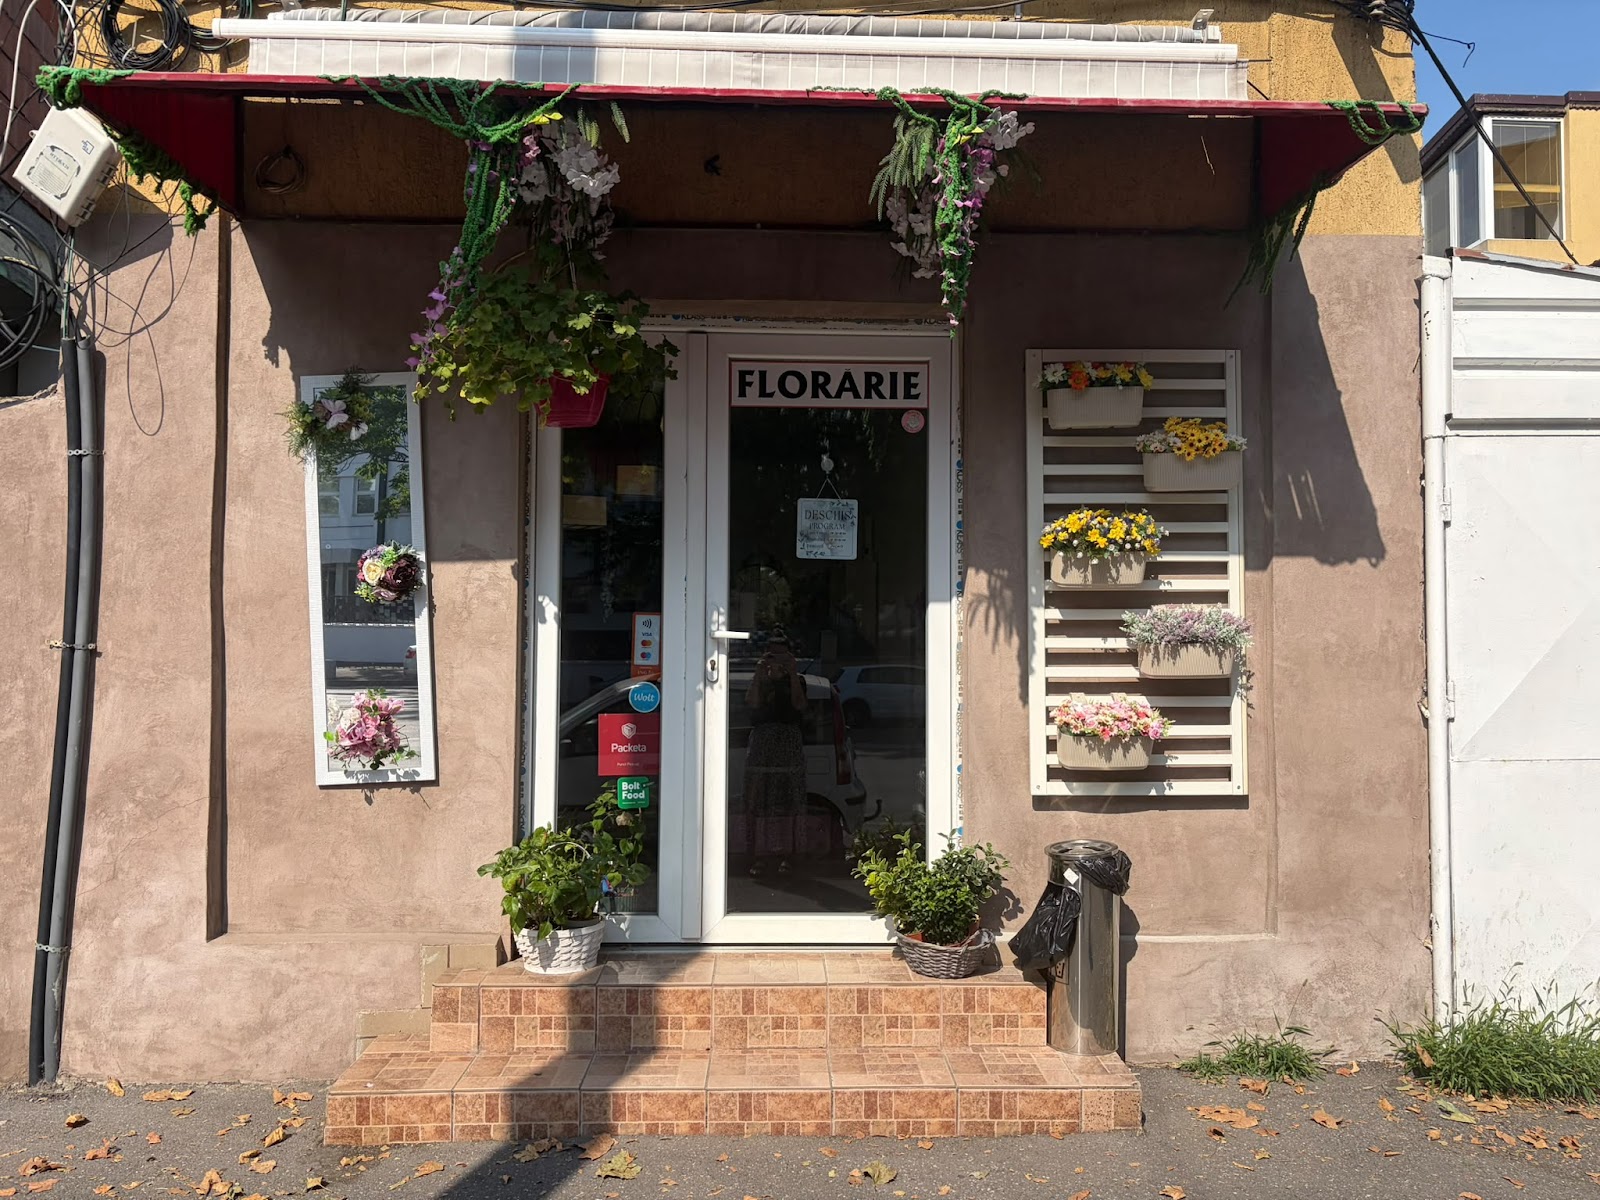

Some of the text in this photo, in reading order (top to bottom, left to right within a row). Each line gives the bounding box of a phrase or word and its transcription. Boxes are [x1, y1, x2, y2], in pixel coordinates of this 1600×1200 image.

[737, 368, 921, 400] FLORĂRIE
[804, 509, 851, 521] DESCHIS
[809, 522, 846, 530] PROGRAM
[633, 693, 655, 702] Wolt
[610, 742, 647, 753] Packeta
[621, 781, 641, 790] Bolt
[621, 790, 645, 800] Food
